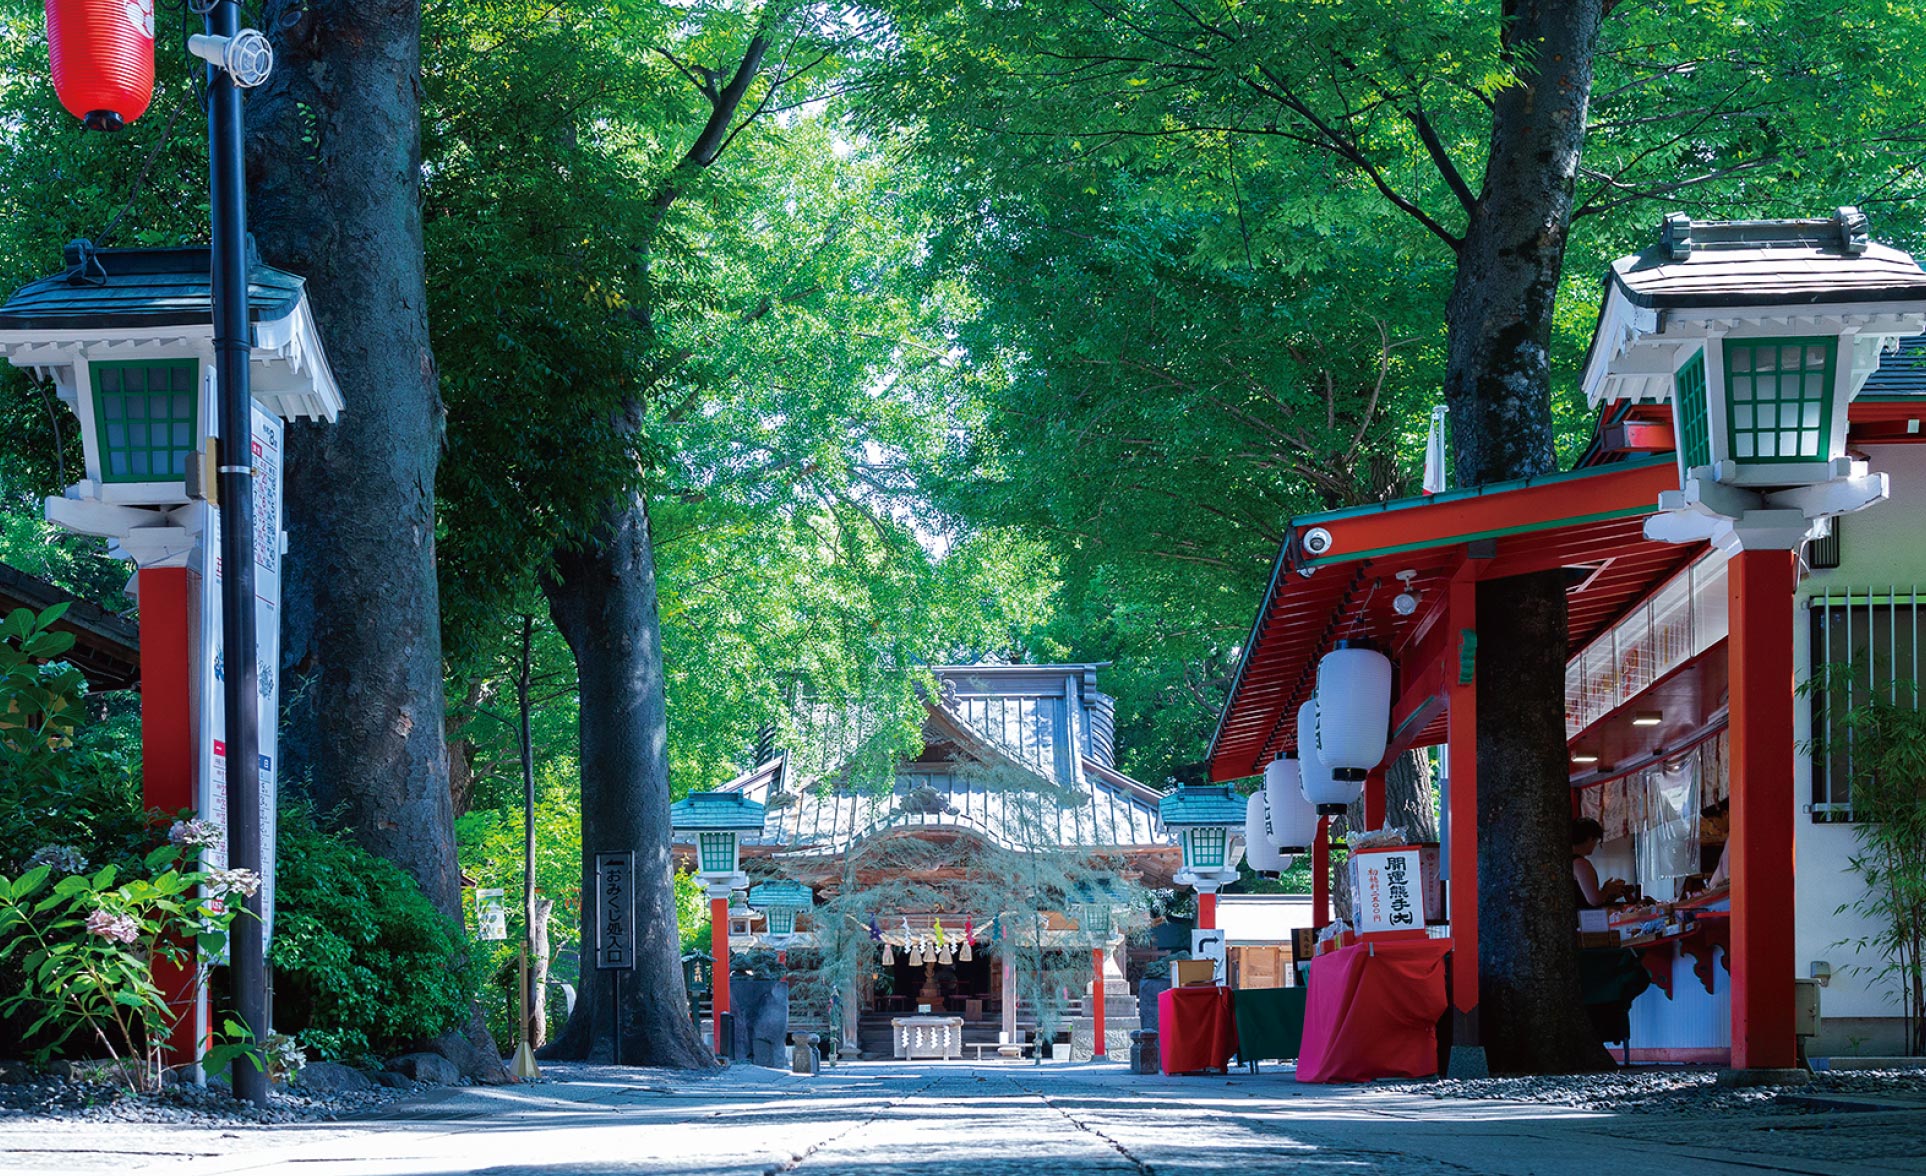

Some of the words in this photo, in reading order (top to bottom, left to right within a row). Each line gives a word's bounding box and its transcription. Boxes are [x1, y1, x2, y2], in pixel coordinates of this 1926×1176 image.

[606, 870, 623, 963] おみくじ処入口
